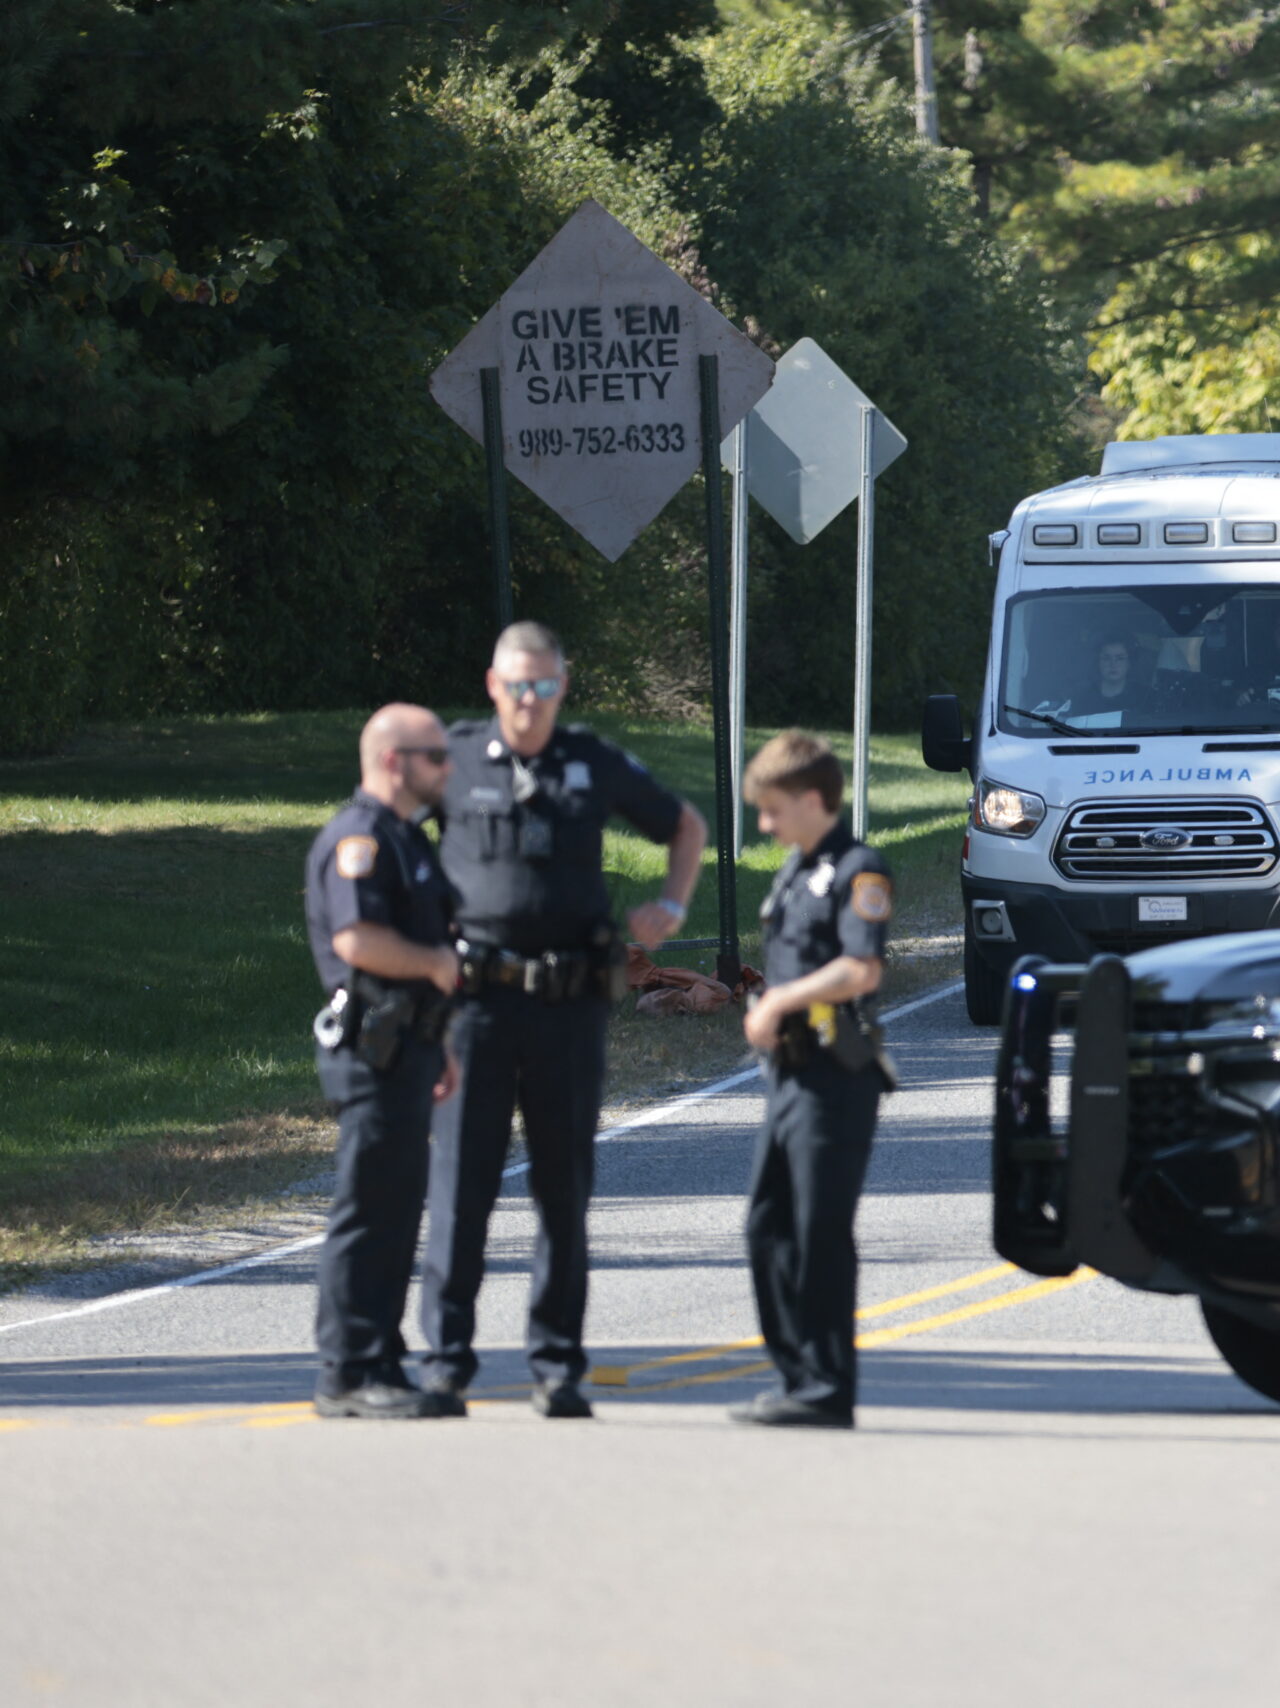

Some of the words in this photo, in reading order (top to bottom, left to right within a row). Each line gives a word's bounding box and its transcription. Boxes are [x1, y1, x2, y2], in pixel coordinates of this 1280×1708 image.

[512, 306, 603, 340] GIVE
[615, 305, 680, 336] 'EM
[516, 344, 541, 372] A
[553, 338, 679, 371] BRAKE
[527, 372, 672, 405] SAFETY
[519, 423, 685, 457] 989-752-6333
